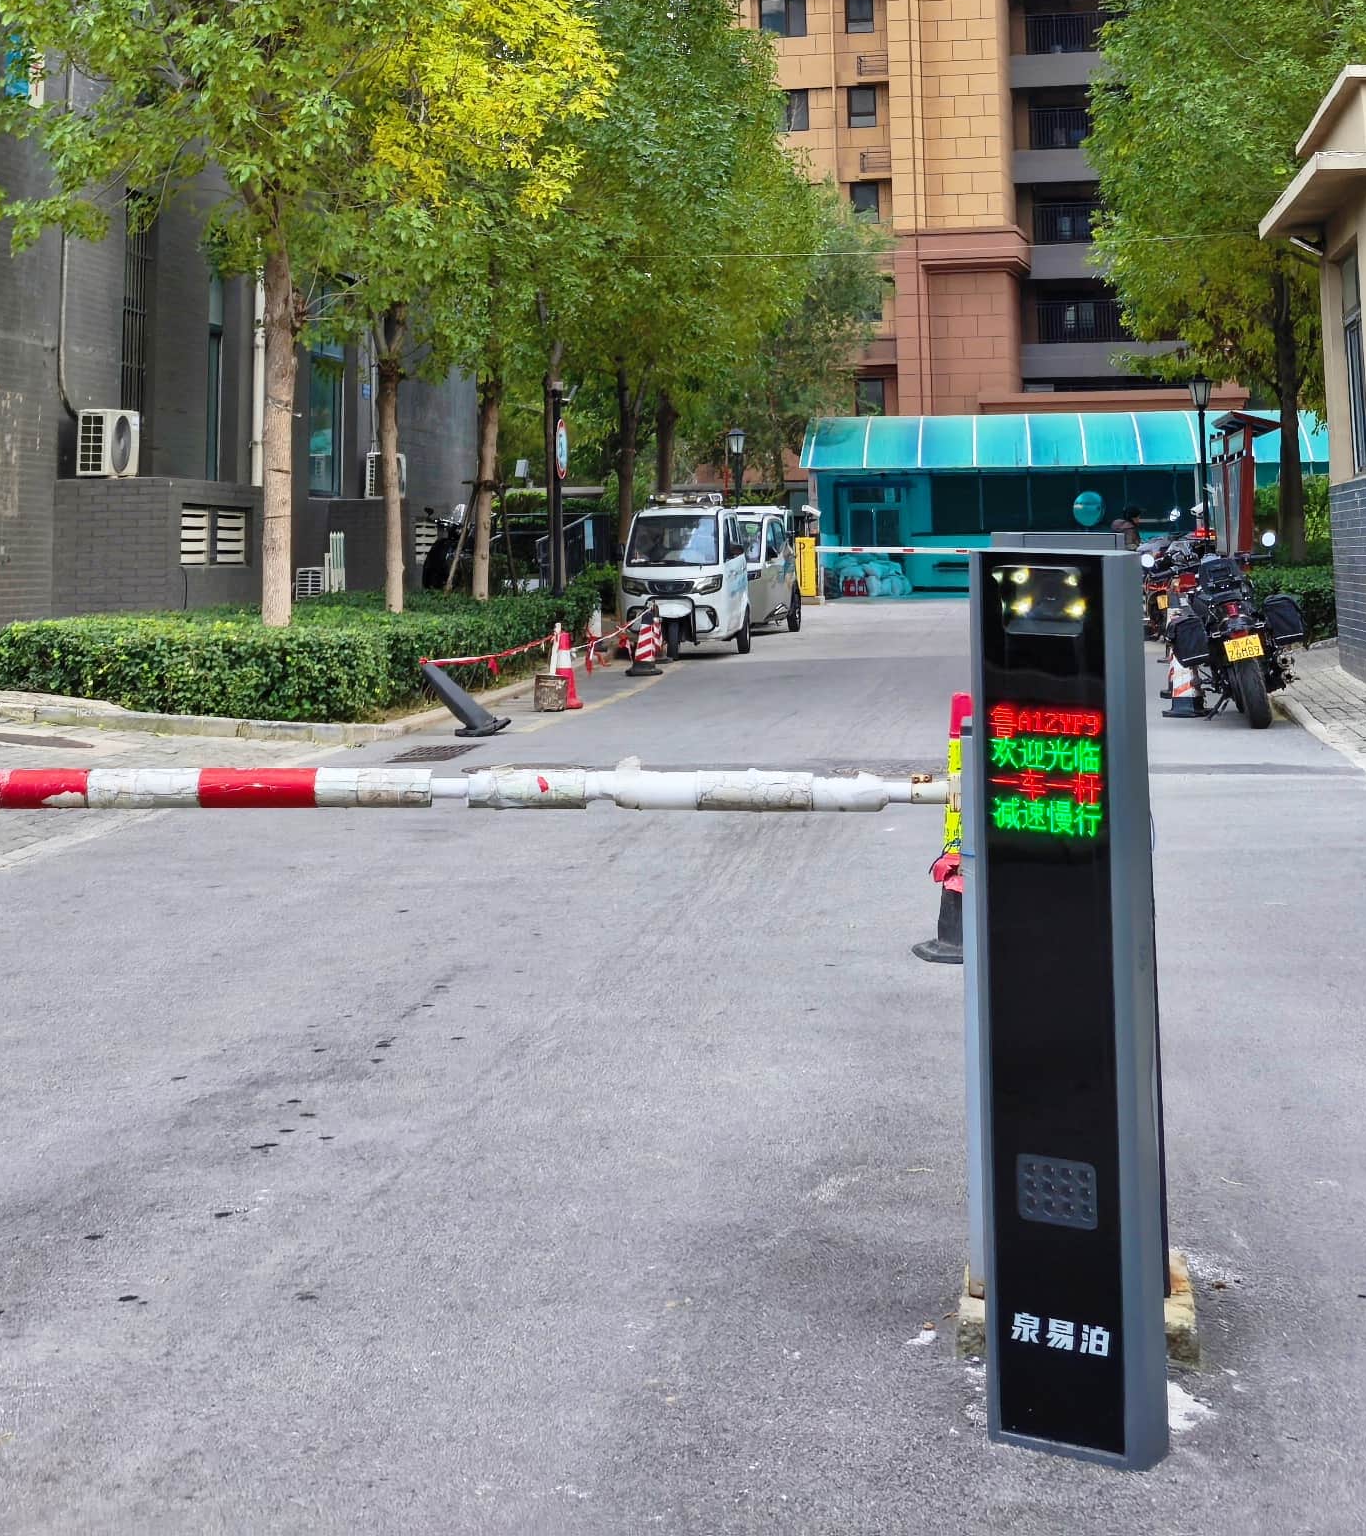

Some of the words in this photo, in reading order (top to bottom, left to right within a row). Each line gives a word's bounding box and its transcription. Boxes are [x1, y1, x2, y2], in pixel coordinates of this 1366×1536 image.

[990, 738, 1100, 773] 欢迎光临
[991, 798, 1102, 837] 减速慢行
[1011, 1312, 1110, 1357] 泉易泊
